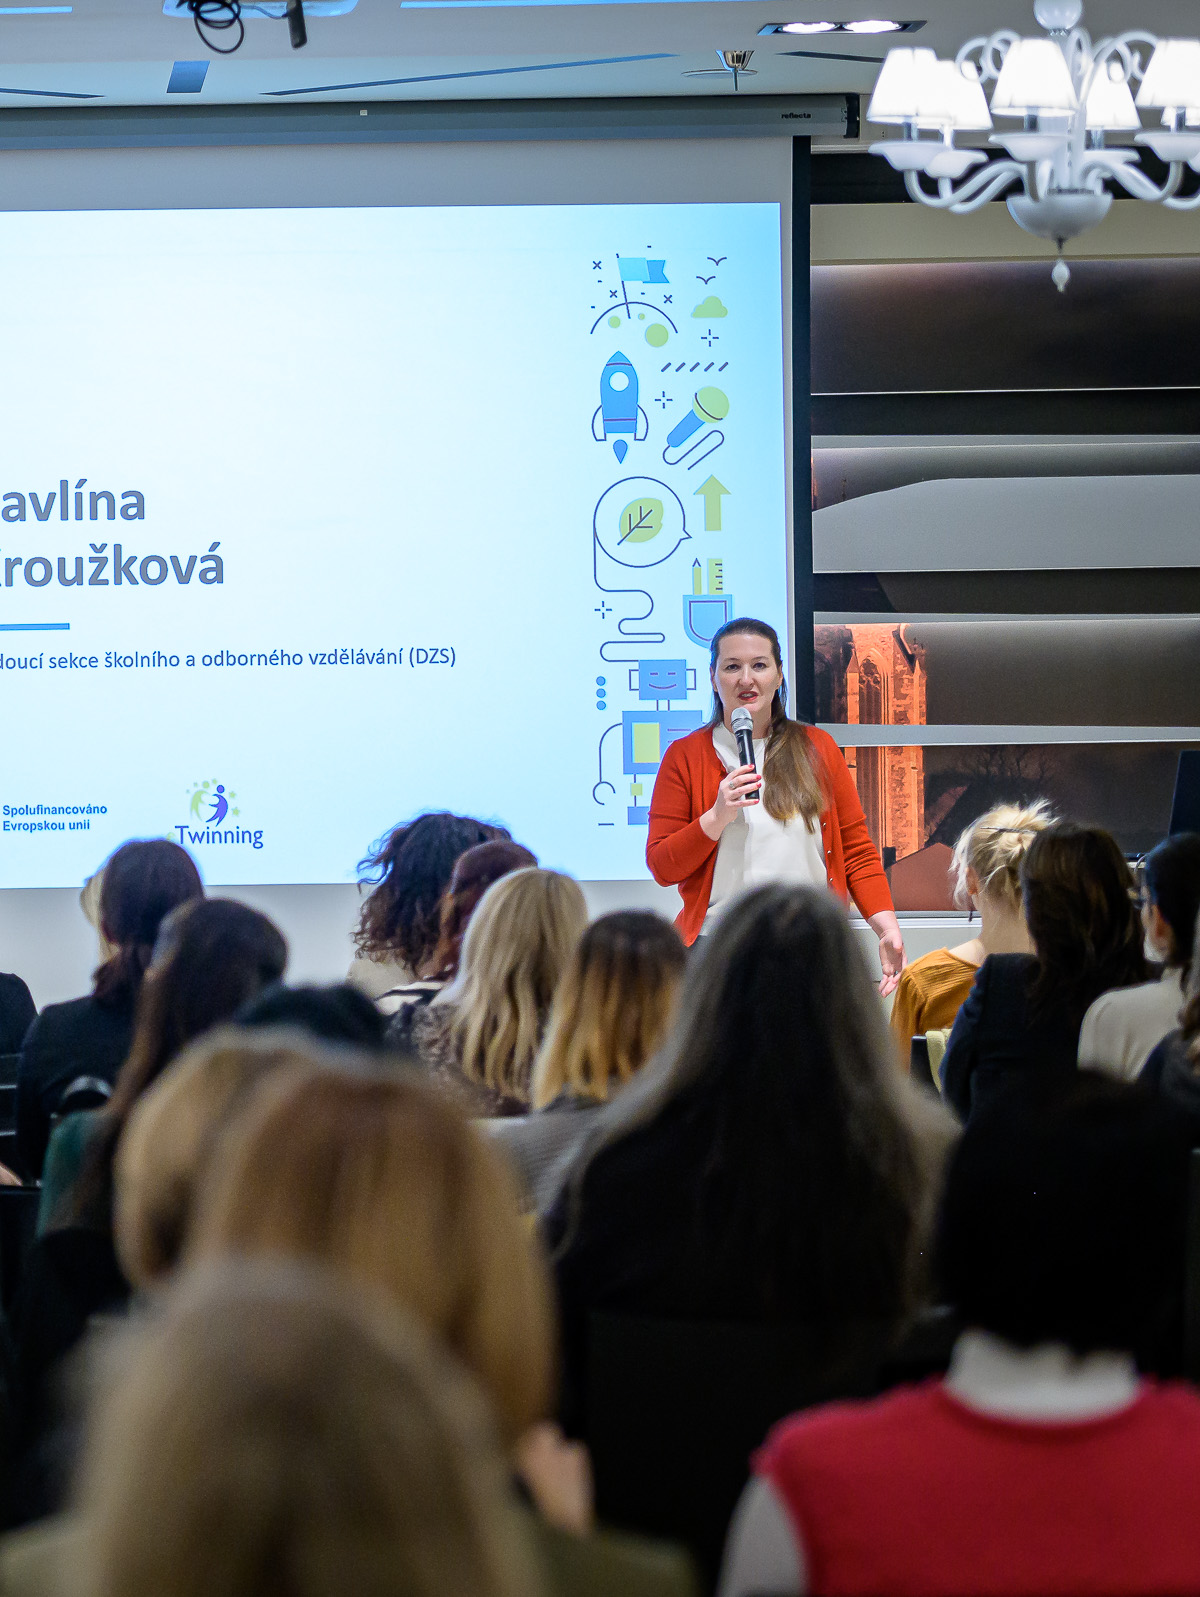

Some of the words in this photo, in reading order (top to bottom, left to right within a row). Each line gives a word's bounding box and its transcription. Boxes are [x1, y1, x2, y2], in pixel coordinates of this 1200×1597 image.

[48, 654, 99, 669] sekce
[104, 649, 180, 669] školního
[185, 655, 196, 668] a
[201, 648, 304, 668] odborného
[308, 647, 404, 667] vzdělávání
[409, 646, 456, 669] (DZS)
[2, 804, 108, 818] Spolufinancováno
[2, 820, 65, 834] Evropskou
[68, 819, 90, 831] unii
